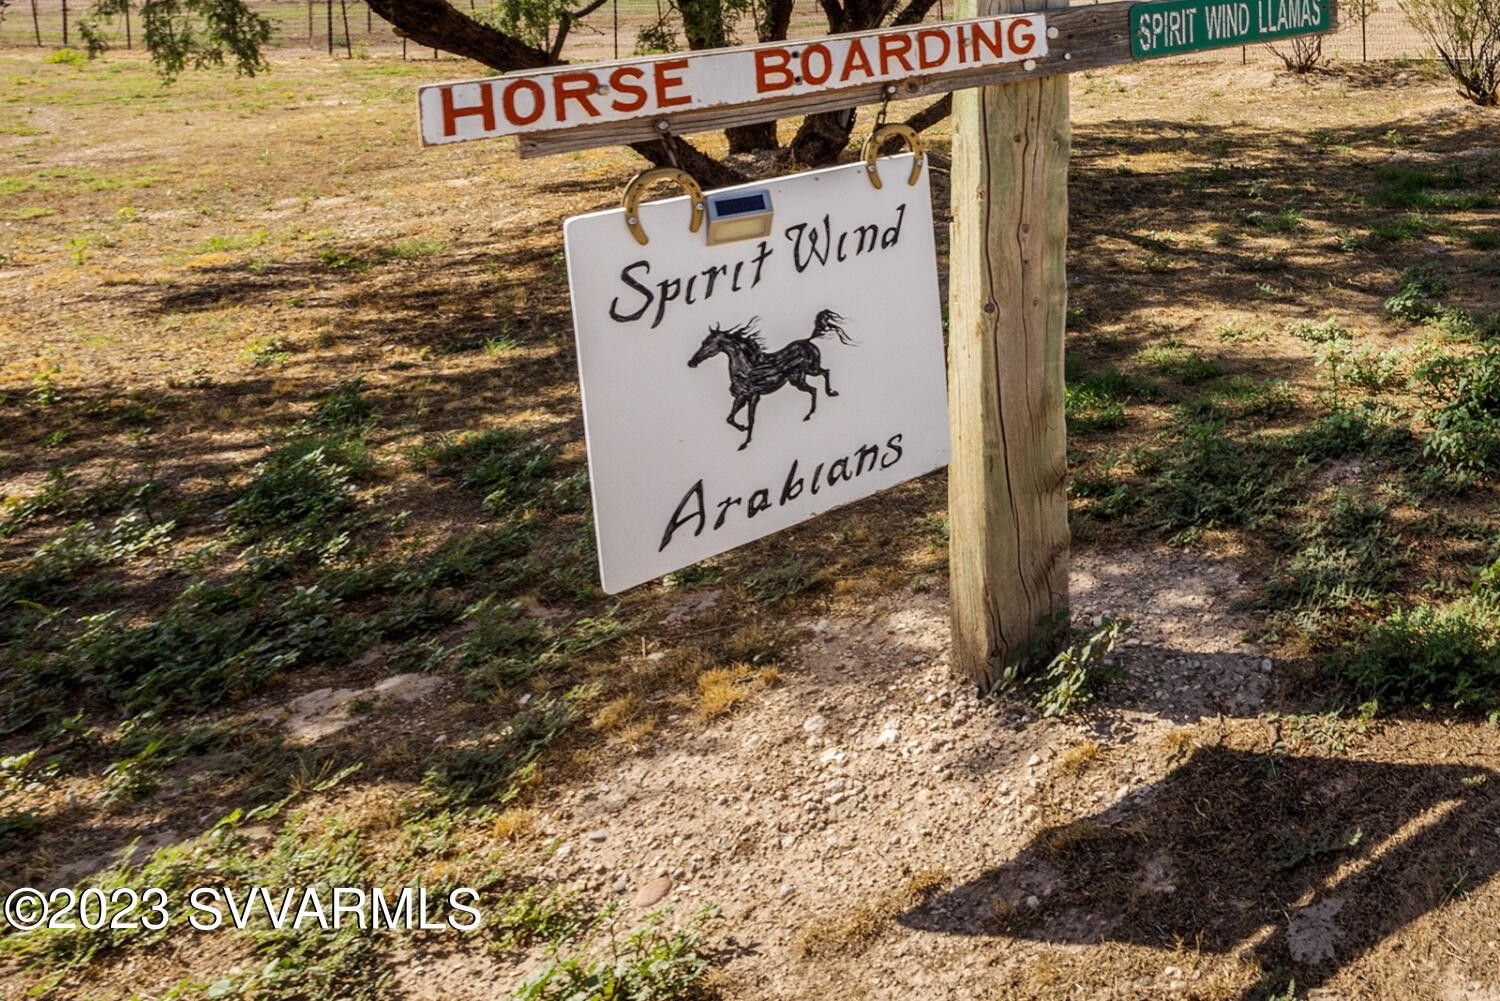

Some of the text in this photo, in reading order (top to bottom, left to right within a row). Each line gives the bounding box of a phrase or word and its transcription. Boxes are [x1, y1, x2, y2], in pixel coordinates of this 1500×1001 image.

[441, 19, 1037, 138] HORSE BOARDING
[1138, 8, 1197, 51] SPIRIT
[1205, 3, 1250, 40] WIND
[609, 203, 907, 329] Spirit Wind
[658, 434, 903, 552] Arabians
